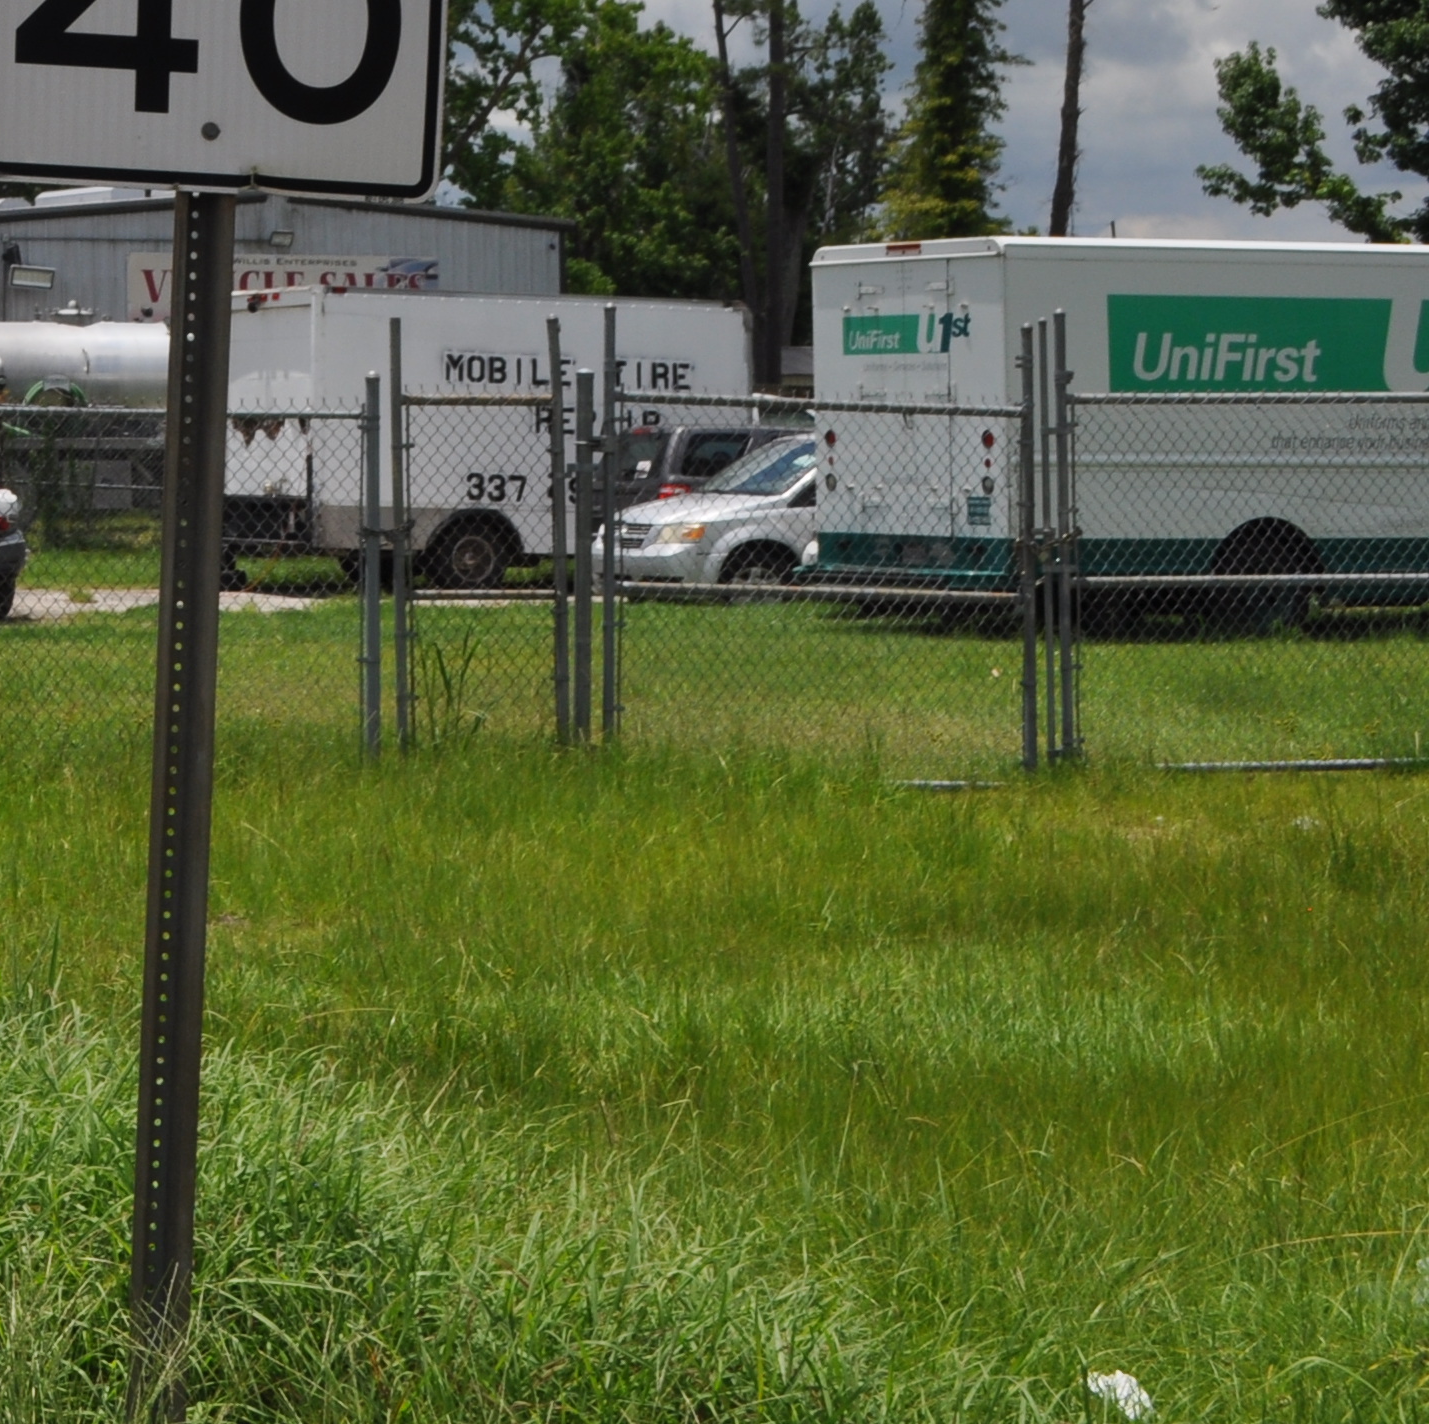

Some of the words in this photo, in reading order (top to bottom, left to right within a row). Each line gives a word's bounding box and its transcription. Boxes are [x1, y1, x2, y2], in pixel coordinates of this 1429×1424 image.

[276, 257, 358, 267] ENTERPRISES
[142, 269, 304, 303] VCLE
[848, 330, 901, 350] UniFirst
[445, 353, 571, 387] MOBILE
[1132, 332, 1322, 382] UniFirst
[466, 472, 527, 502] 337
